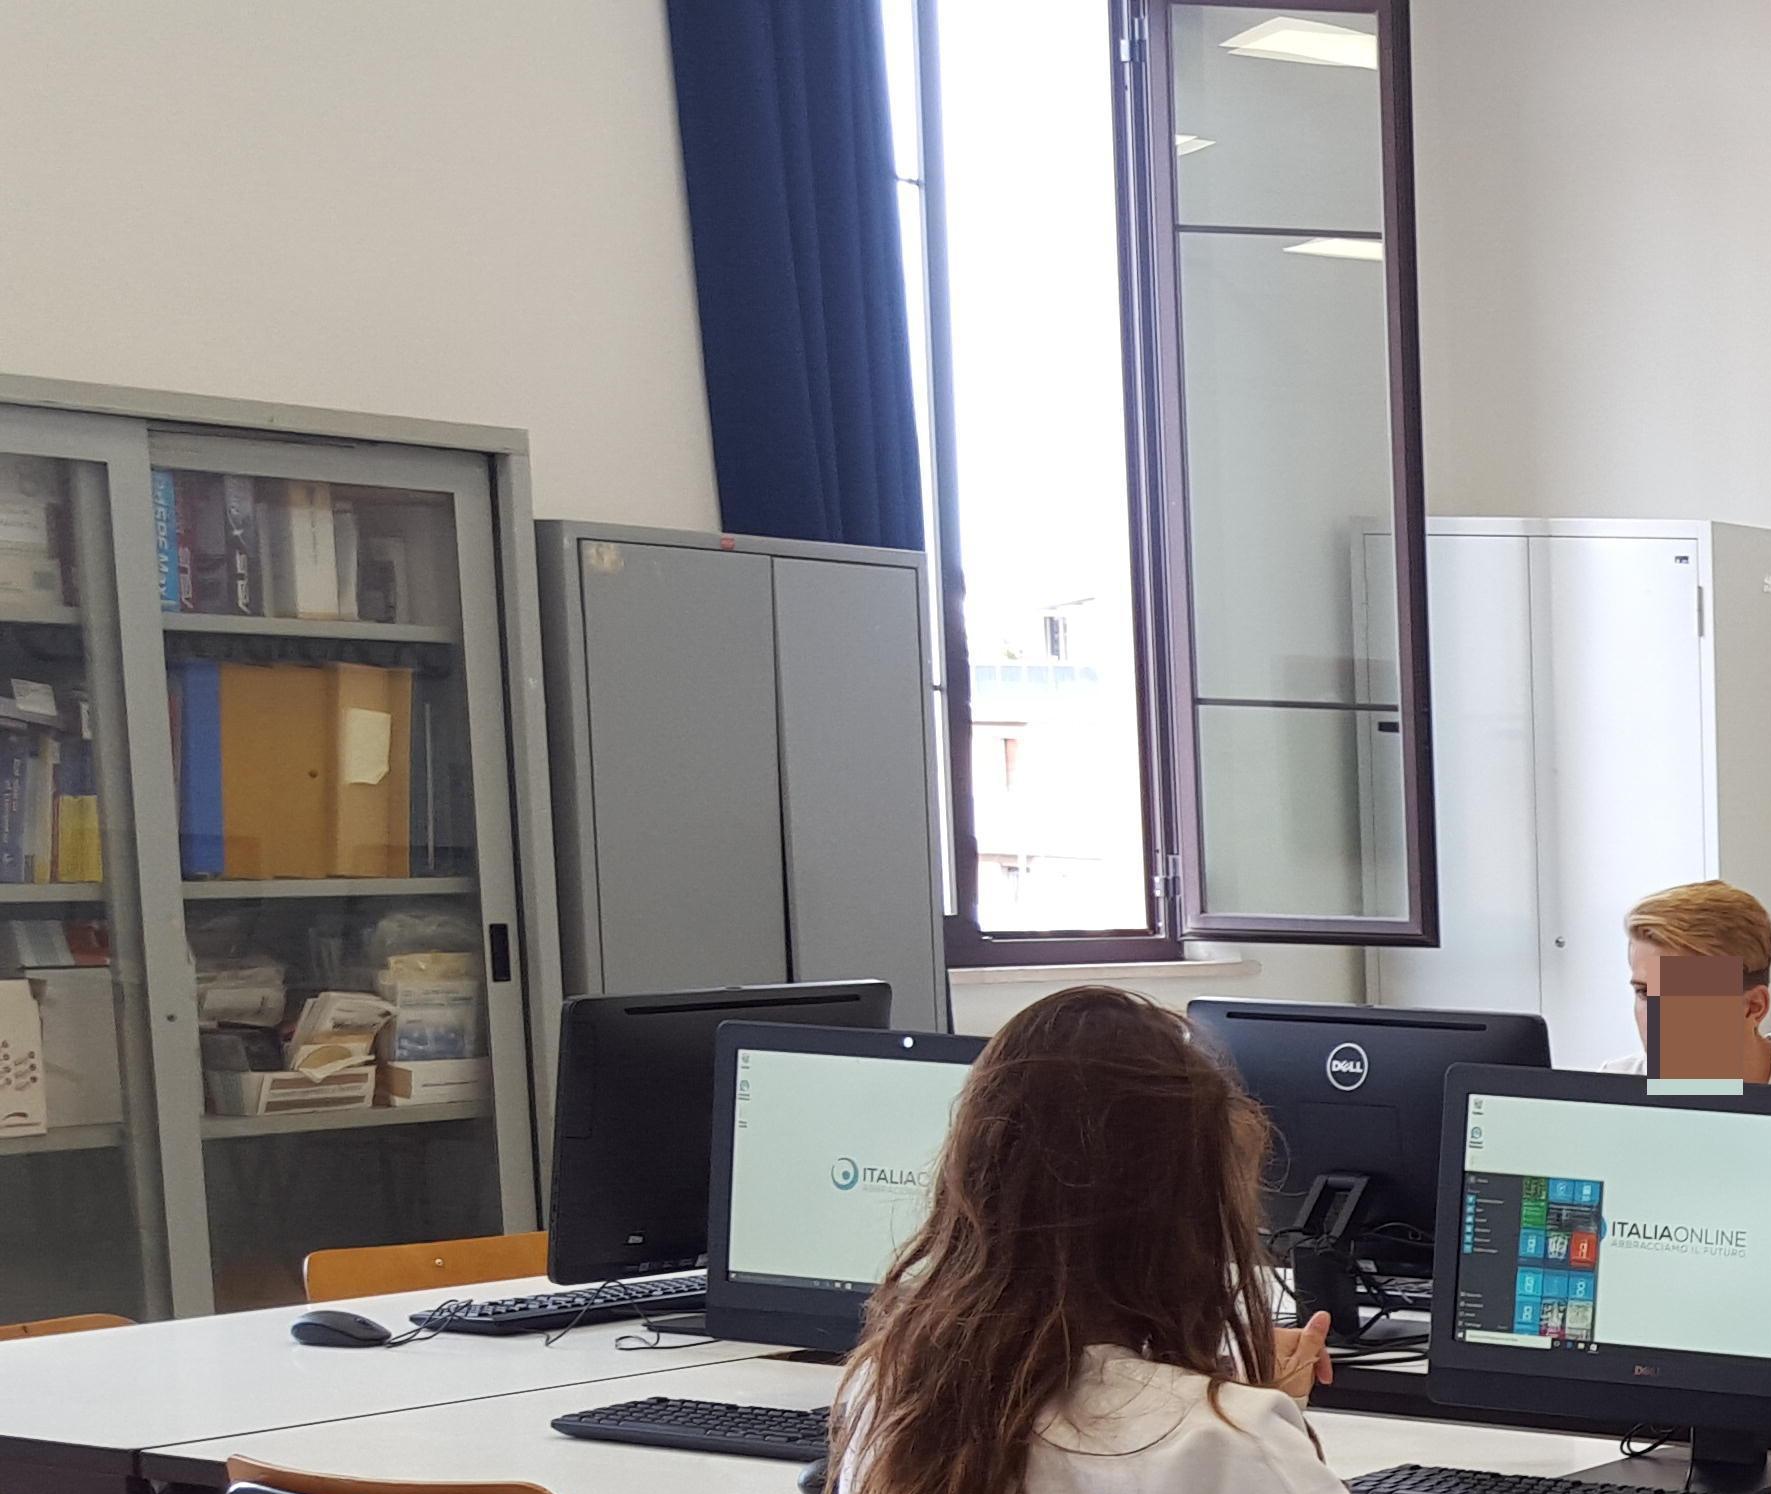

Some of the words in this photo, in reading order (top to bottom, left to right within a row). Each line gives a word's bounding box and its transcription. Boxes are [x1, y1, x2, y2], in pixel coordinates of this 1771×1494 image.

[177, 547, 194, 609] ASUS
[235, 550, 251, 615] ASUS
[1332, 1060, 1363, 1073] DELL
[862, 1167, 931, 1187] ITALIAO
[1611, 1221, 1747, 1248] ITALIAONLINE
[1610, 1240, 1688, 1254] ABBRACCIAMO
[1703, 1247, 1746, 1258] FUTURO
